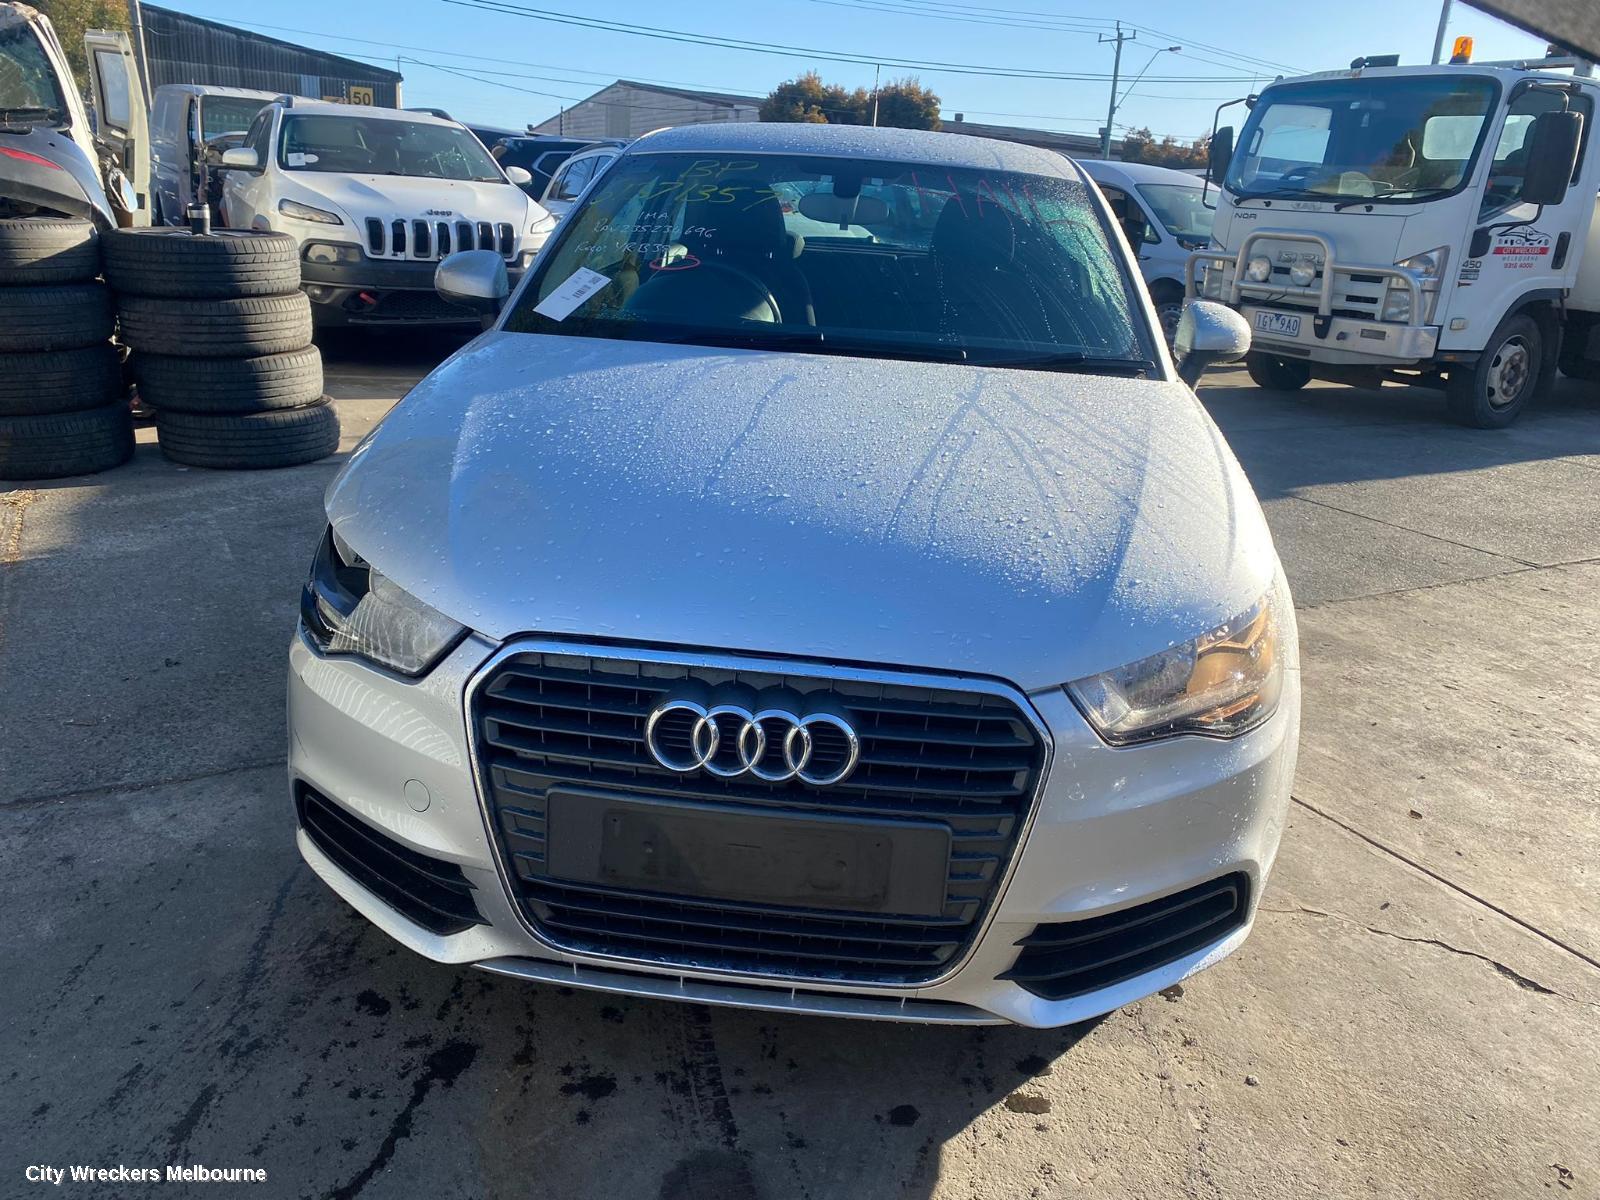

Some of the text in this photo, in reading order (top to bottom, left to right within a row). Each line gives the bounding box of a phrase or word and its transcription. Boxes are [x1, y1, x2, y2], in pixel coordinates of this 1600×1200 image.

[353, 92, 371, 105] 50
[426, 208, 453, 216] Jeep
[1462, 260, 1482, 269] 450
